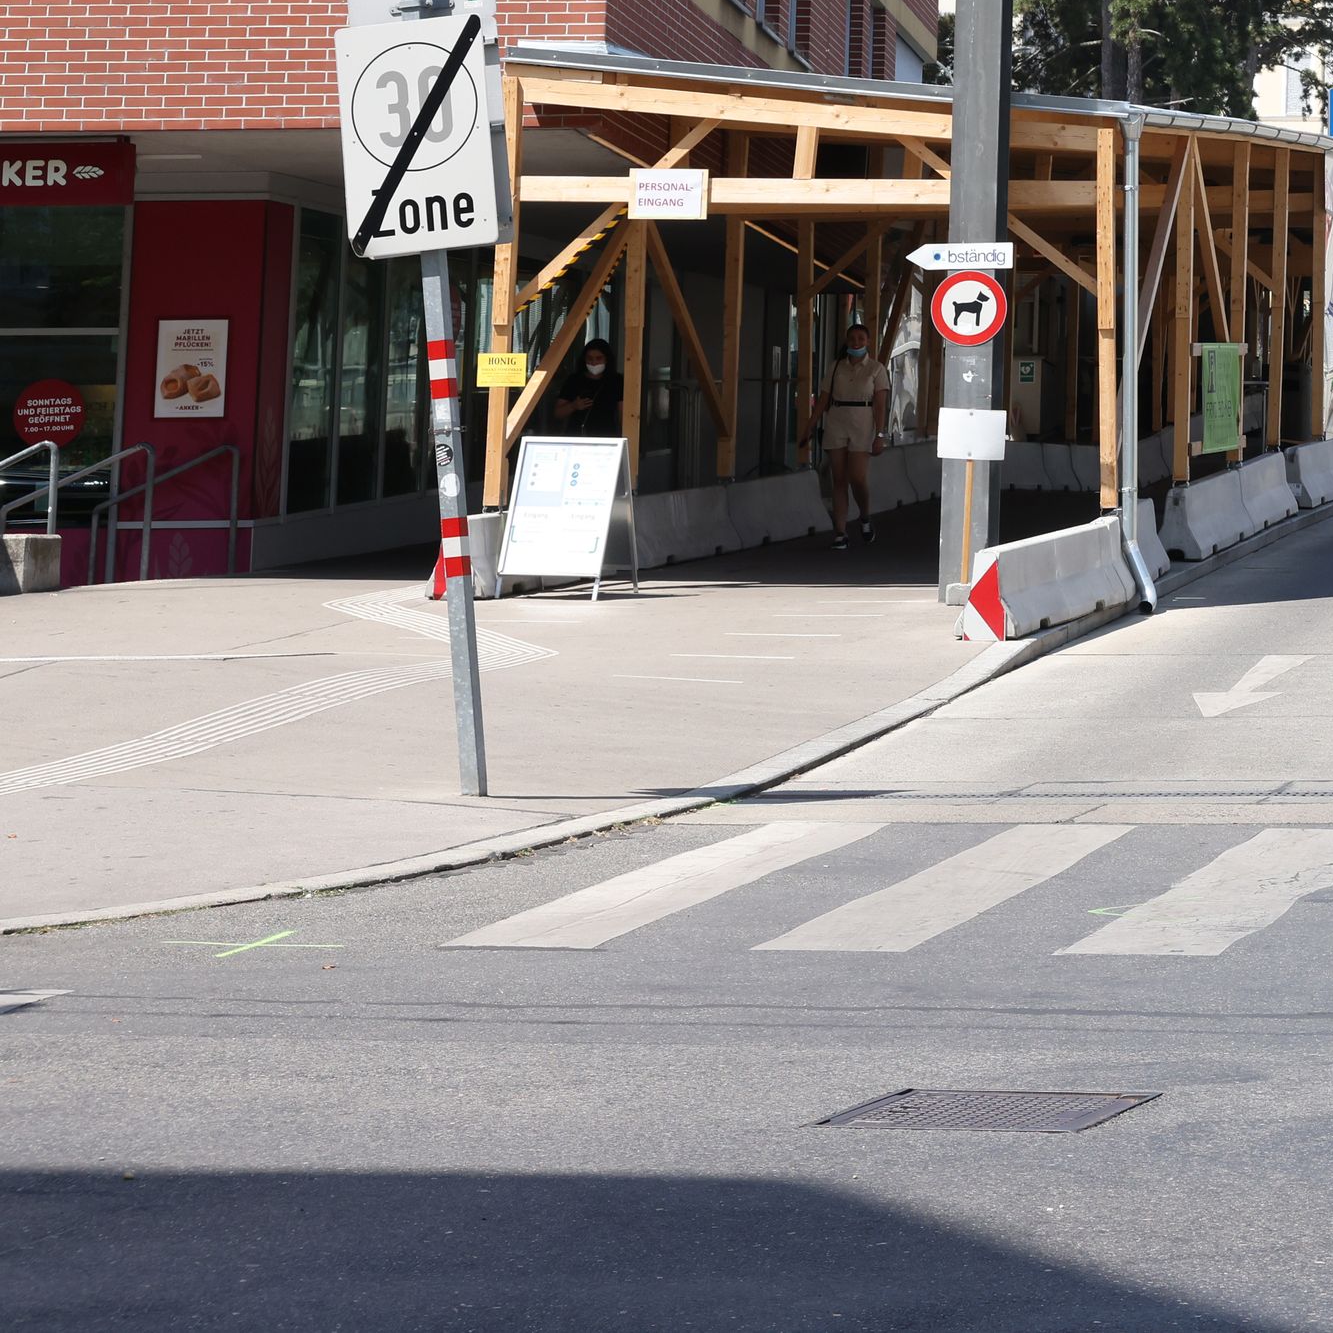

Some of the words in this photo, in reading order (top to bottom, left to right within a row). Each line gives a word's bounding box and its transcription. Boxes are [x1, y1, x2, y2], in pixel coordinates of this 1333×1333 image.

[375, 65, 454, 148] 30
[638, 182, 694, 192] PERSONAL-
[638, 198, 684, 207] EINGANG
[174, 340, 212, 348] PFLÜCKEN!
[488, 357, 517, 365] HONIG
[26, 397, 73, 407] SONNTAGS
[17, 408, 35, 416] UND
[36, 405, 82, 415] FEIERTAGS
[28, 414, 71, 424] GEÖFFNET
